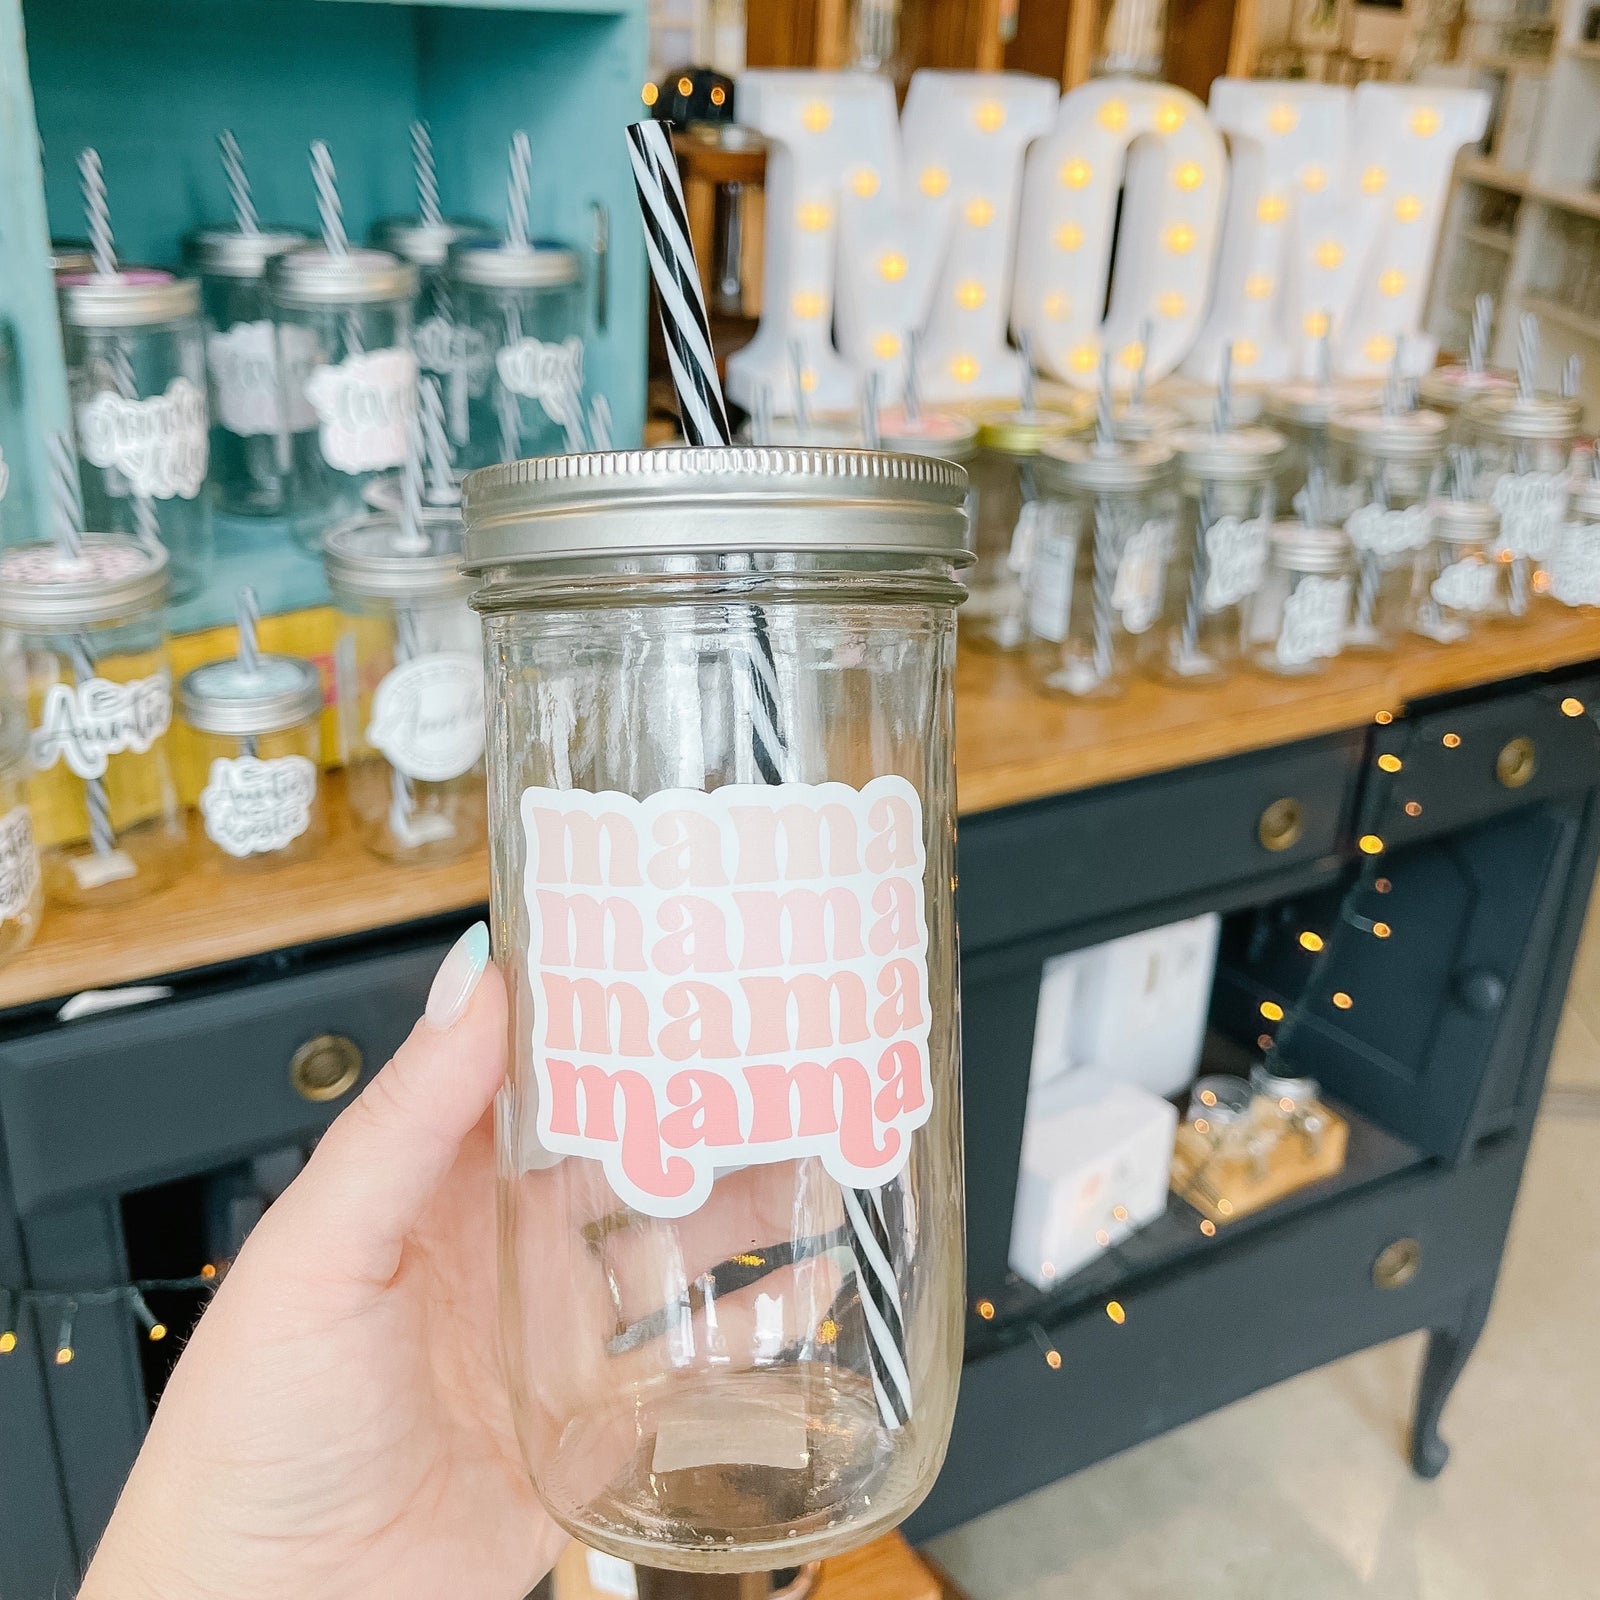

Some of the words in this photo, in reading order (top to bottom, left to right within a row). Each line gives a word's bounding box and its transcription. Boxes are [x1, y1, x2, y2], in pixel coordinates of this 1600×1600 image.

[727, 69, 1490, 413] MOM
[532, 795, 919, 890] mama
[536, 877, 920, 976] mama
[541, 957, 925, 1062] mama
[545, 1040, 926, 1198] mama
